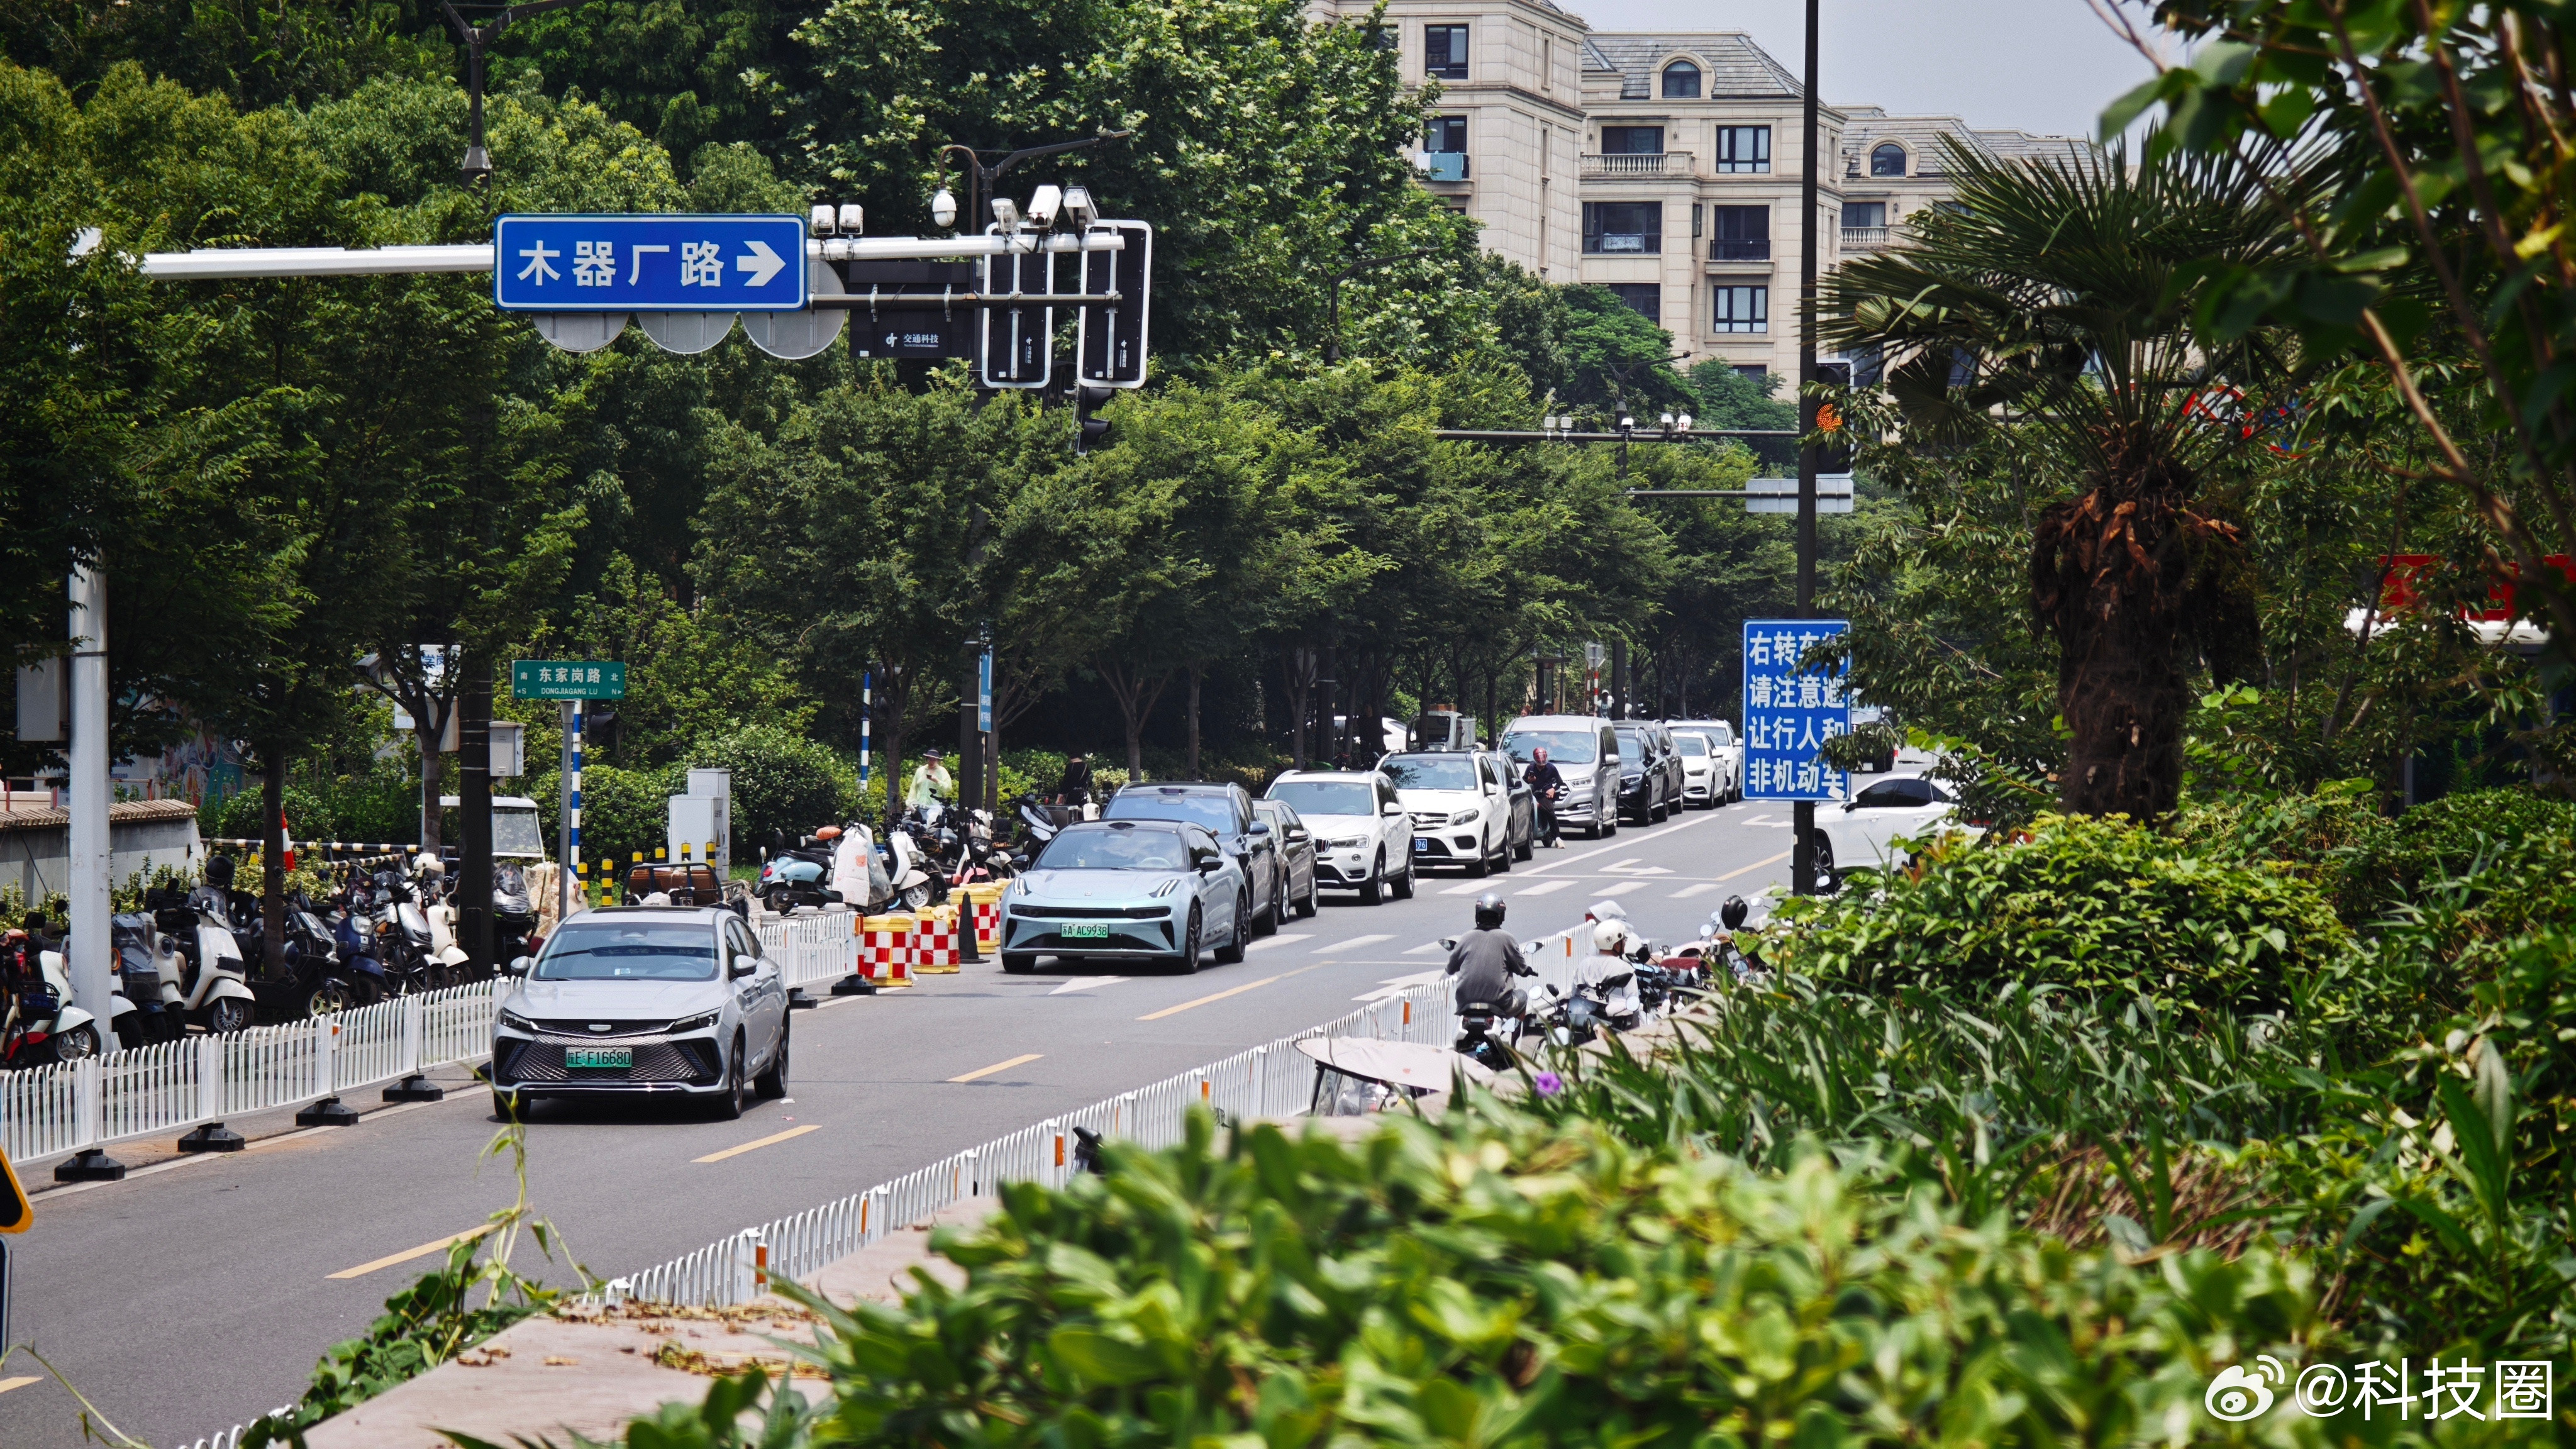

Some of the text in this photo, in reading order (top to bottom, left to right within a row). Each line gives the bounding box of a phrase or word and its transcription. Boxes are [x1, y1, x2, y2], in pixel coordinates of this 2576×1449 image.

[517, 240, 724, 287] 木器厂路
[903, 333, 940, 344] 交通科技
[1748, 631, 1845, 666] 右转车
[520, 667, 618, 684] 南 东家岗路 北
[1748, 674, 1845, 709] 请注意避
[1748, 716, 1845, 751] 让行人和
[1748, 758, 1845, 794] 非机动车
